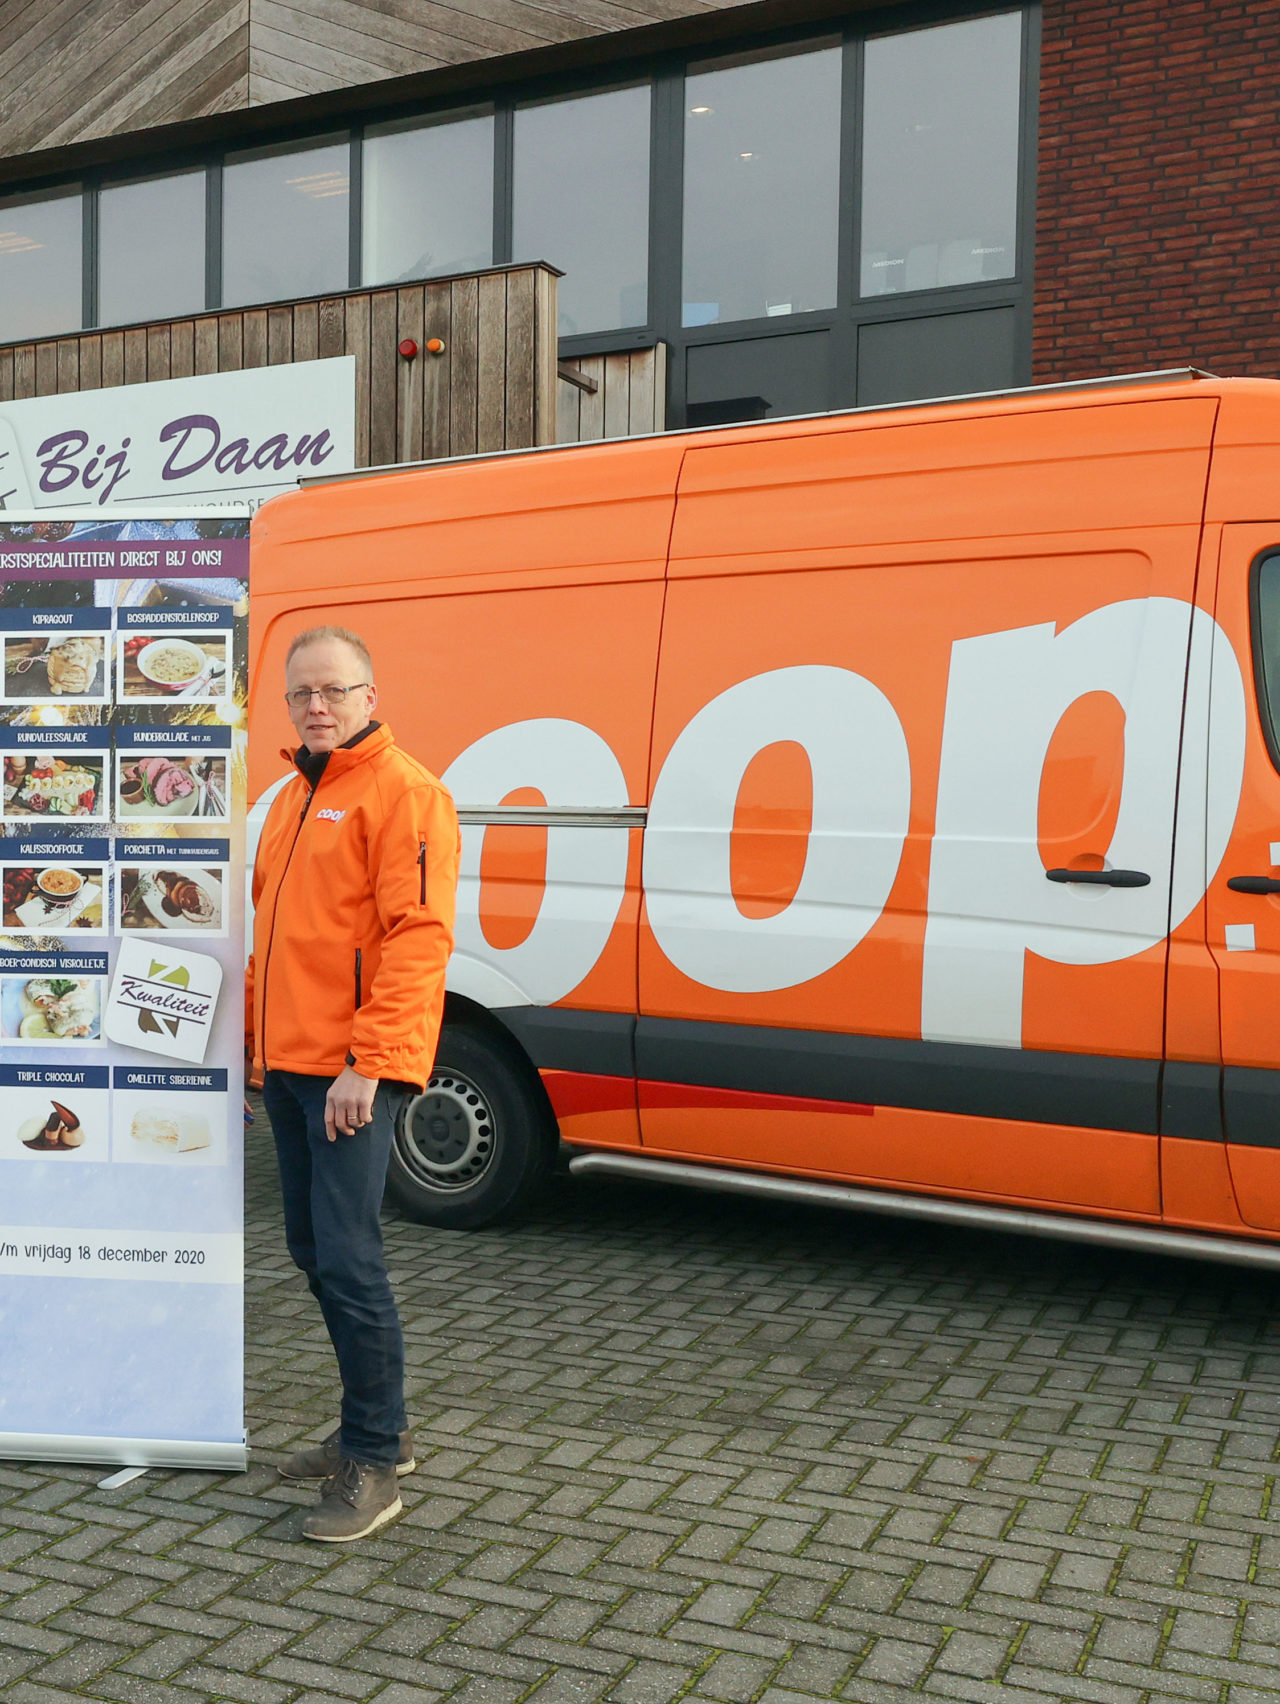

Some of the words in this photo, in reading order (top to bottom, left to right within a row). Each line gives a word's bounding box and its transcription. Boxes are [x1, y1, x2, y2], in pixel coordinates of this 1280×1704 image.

[36, 429, 131, 505] Bij
[159, 414, 334, 480] Daan
[120, 550, 160, 567] DIRECT
[166, 550, 186, 566] BIJ
[191, 549, 222, 566] ONS!
[32, 614, 74, 625] KIPRAGOUT
[127, 612, 220, 623] BOSPADDENSTOELENSOEP
[17, 732, 88, 743] RUNDVLEESSALADE
[133, 732, 190, 742] RUNDERROLLADE
[20, 844, 85, 854] KALFSSTOOFPOTJE
[124, 844, 166, 855] PORCHETTA
[60, 957, 106, 969] VISROLLETJE
[120, 981, 210, 1016] Kwaliteit
[17, 1071, 42, 1082] TRIPLE
[45, 1072, 86, 1083] CHOCOLAT
[127, 1074, 167, 1085] OMELETTE
[169, 1074, 213, 1086] SIBERIENNE
[25, 1243, 72, 1263] vrijdag
[78, 1245, 91, 1260] 18
[98, 1246, 168, 1263] december
[174, 1249, 206, 1265] 2020
